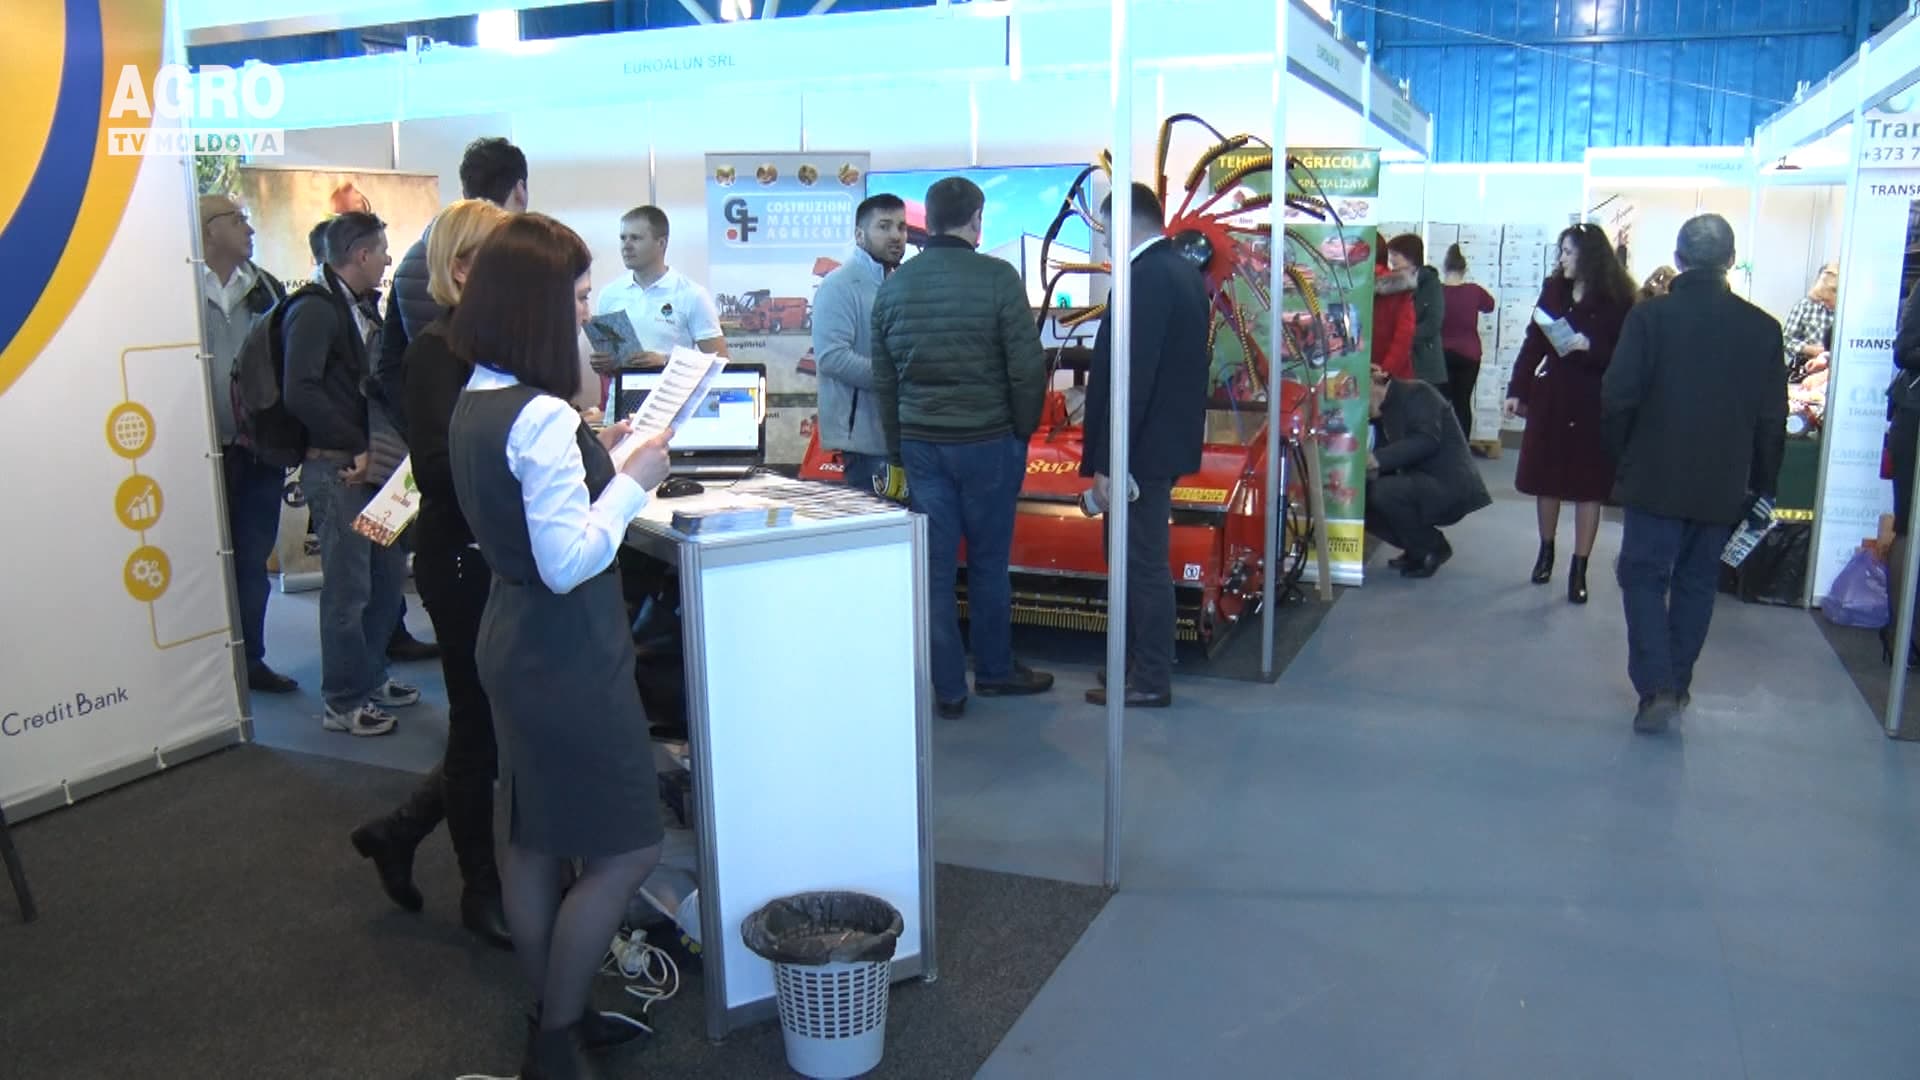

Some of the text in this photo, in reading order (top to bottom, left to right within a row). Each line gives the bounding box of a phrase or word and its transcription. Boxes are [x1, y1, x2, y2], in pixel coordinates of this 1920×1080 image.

[623, 55, 736, 75] EUROALUN SRL
[1862, 147, 1904, 161] +373
[766, 200, 851, 213] COSTRUZIONI
